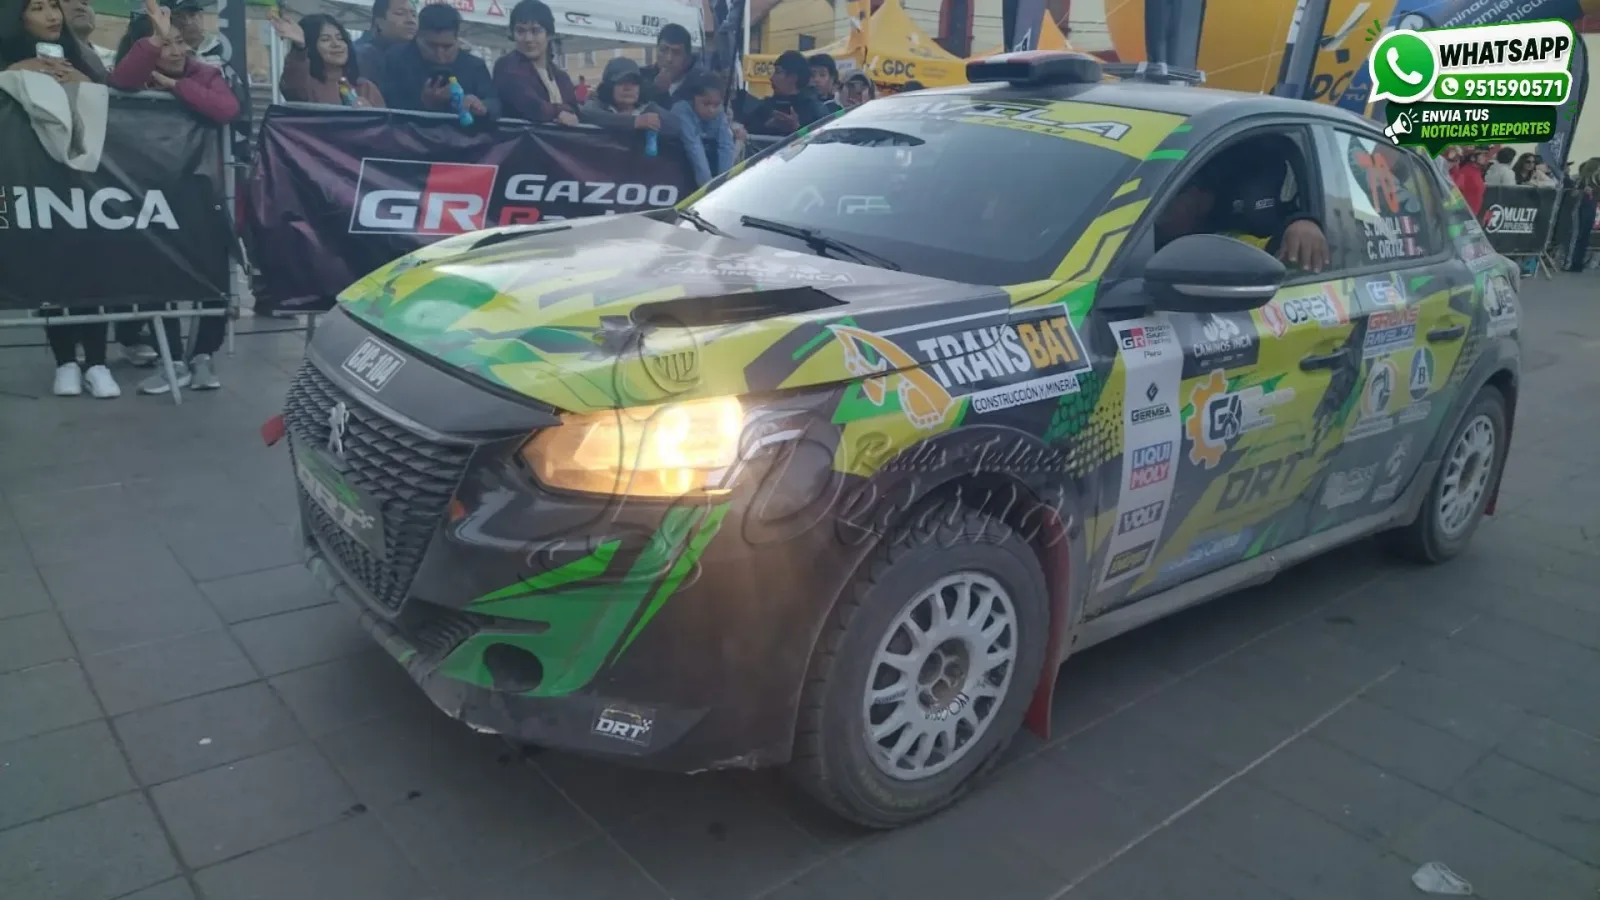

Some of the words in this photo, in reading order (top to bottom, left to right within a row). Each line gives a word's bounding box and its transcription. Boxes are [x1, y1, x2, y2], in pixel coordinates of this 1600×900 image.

[504, 173, 679, 206] GAZOO
[13, 186, 180, 230] INCA
[358, 190, 484, 230] GR
[1504, 207, 1538, 222] MULTI
[1366, 240, 1378, 260] C.
[1378, 238, 1405, 259] ORTIZ
[916, 317, 1080, 388] TRANSBAT
[1122, 335, 1146, 350] GR
[974, 386, 1039, 412] CONSTRUCCIÓN
[1131, 405, 1171, 422] GERMSA
[1133, 443, 1172, 467] LIQUI
[1131, 464, 1169, 488] MOLY
[1215, 453, 1304, 511] DRT
[1123, 502, 1162, 532] VOLT
[595, 717, 645, 739] DRT
